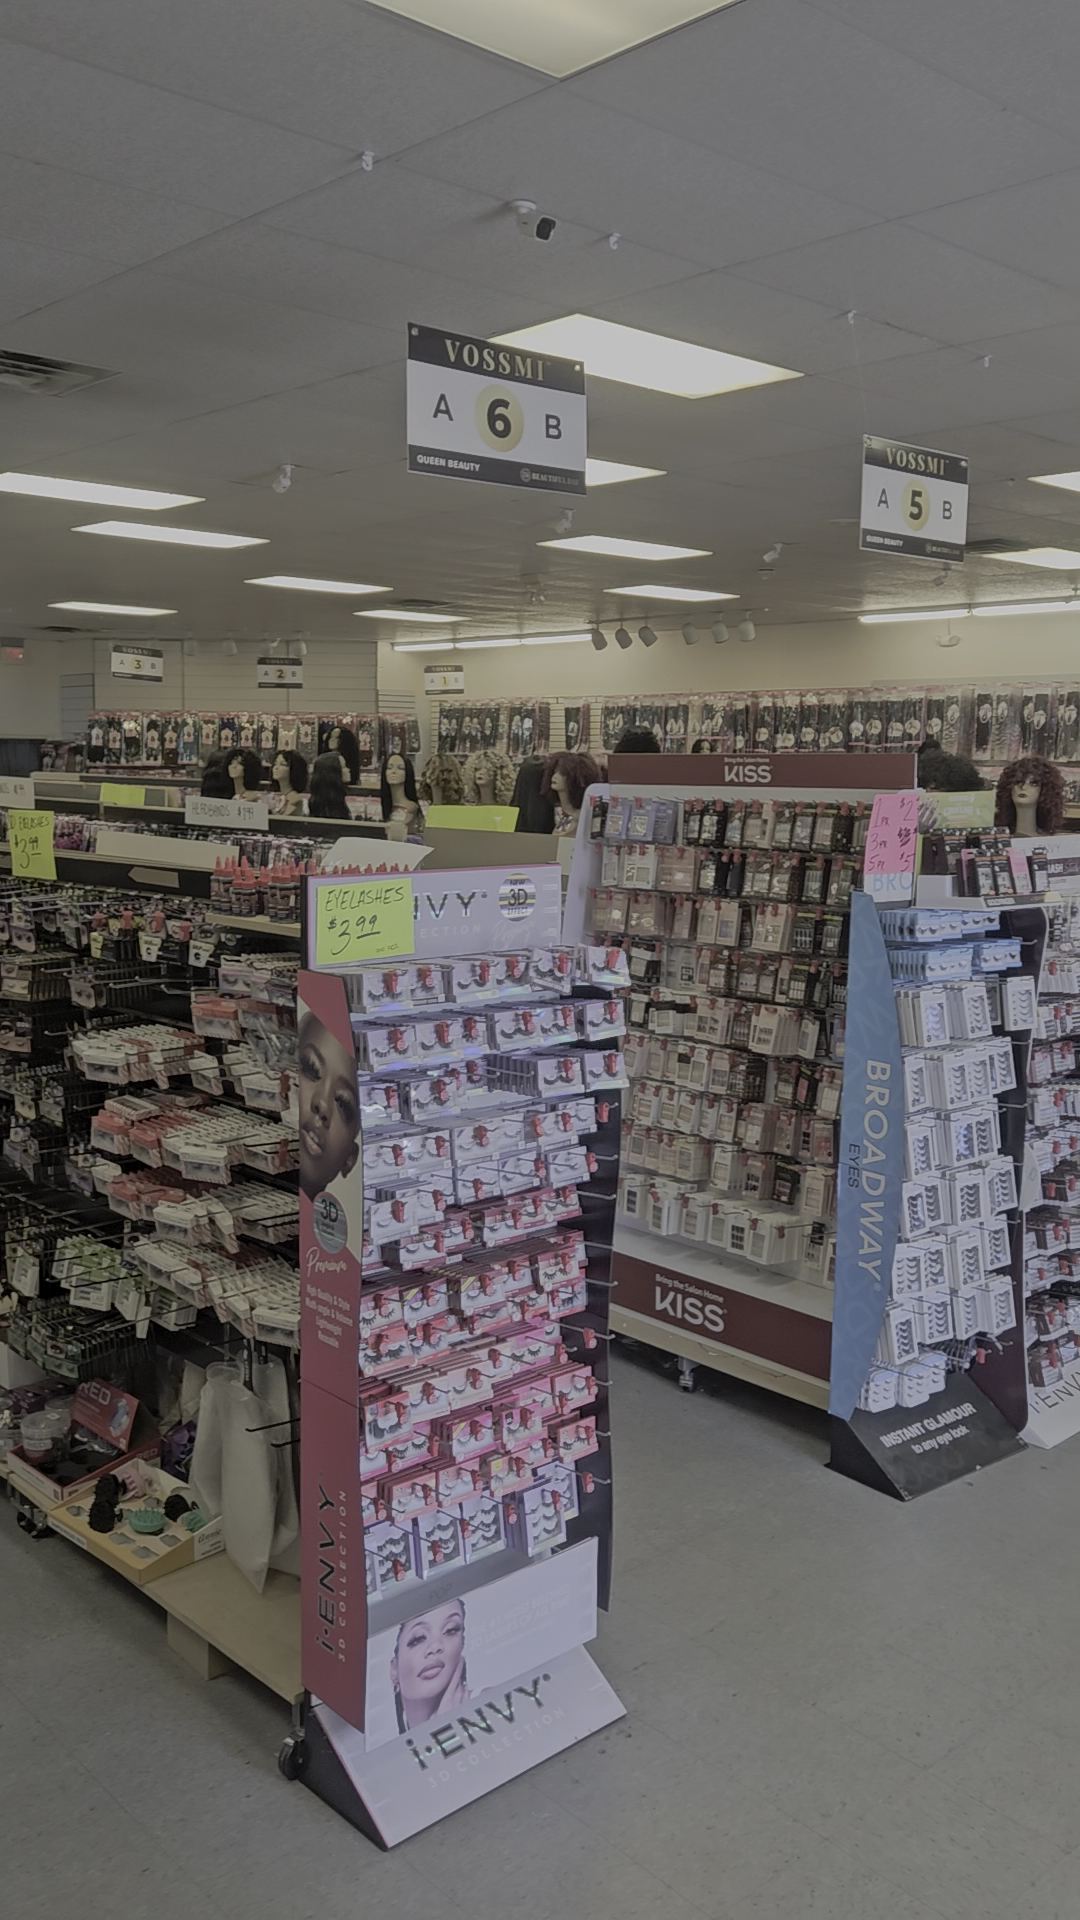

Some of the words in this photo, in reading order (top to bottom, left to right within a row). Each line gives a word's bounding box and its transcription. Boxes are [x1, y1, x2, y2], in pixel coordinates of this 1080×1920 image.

[444, 338, 545, 381] VOSSMI
[432, 393, 454, 421] A
[487, 398, 512, 439] 6
[545, 414, 562, 440] B
[417, 454, 446, 467] QUEEN
[447, 459, 481, 472] BEAUTY
[886, 447, 945, 475] VOSSMI
[877, 488, 889, 509] A
[909, 490, 923, 520] 5
[942, 500, 953, 520] B
[134, 659, 142, 669] 3
[150, 662, 156, 670] B
[276, 669, 284, 678] 2
[724, 765, 772, 783] KISS
[325, 886, 405, 912] EYELASHES
[507, 888, 528, 906] 3D
[507, 906, 529, 916] EFFECT
[848, 1143, 860, 1189] EYES
[858, 1060, 891, 1281] BROADWAY
[320, 1199, 339, 1223] 3D
[655, 1273, 673, 1288] Bring
[673, 1280, 685, 1290] the
[685, 1283, 704, 1297] Salon
[703, 1289, 725, 1304] Home
[655, 1286, 725, 1332] KISS
[78, 1381, 111, 1406] RED
[879, 1422, 926, 1448] INSTANT
[923, 1402, 978, 1431] GLAMOUR
[911, 1443, 924, 1454] to
[921, 1438, 939, 1450] any
[936, 1432, 953, 1445] eye
[948, 1424, 970, 1438] look
[338, 1491, 347, 1627] COLLECTION
[427, 1768, 450, 1789] 3D
[457, 1705, 567, 1772] COLLECTION
